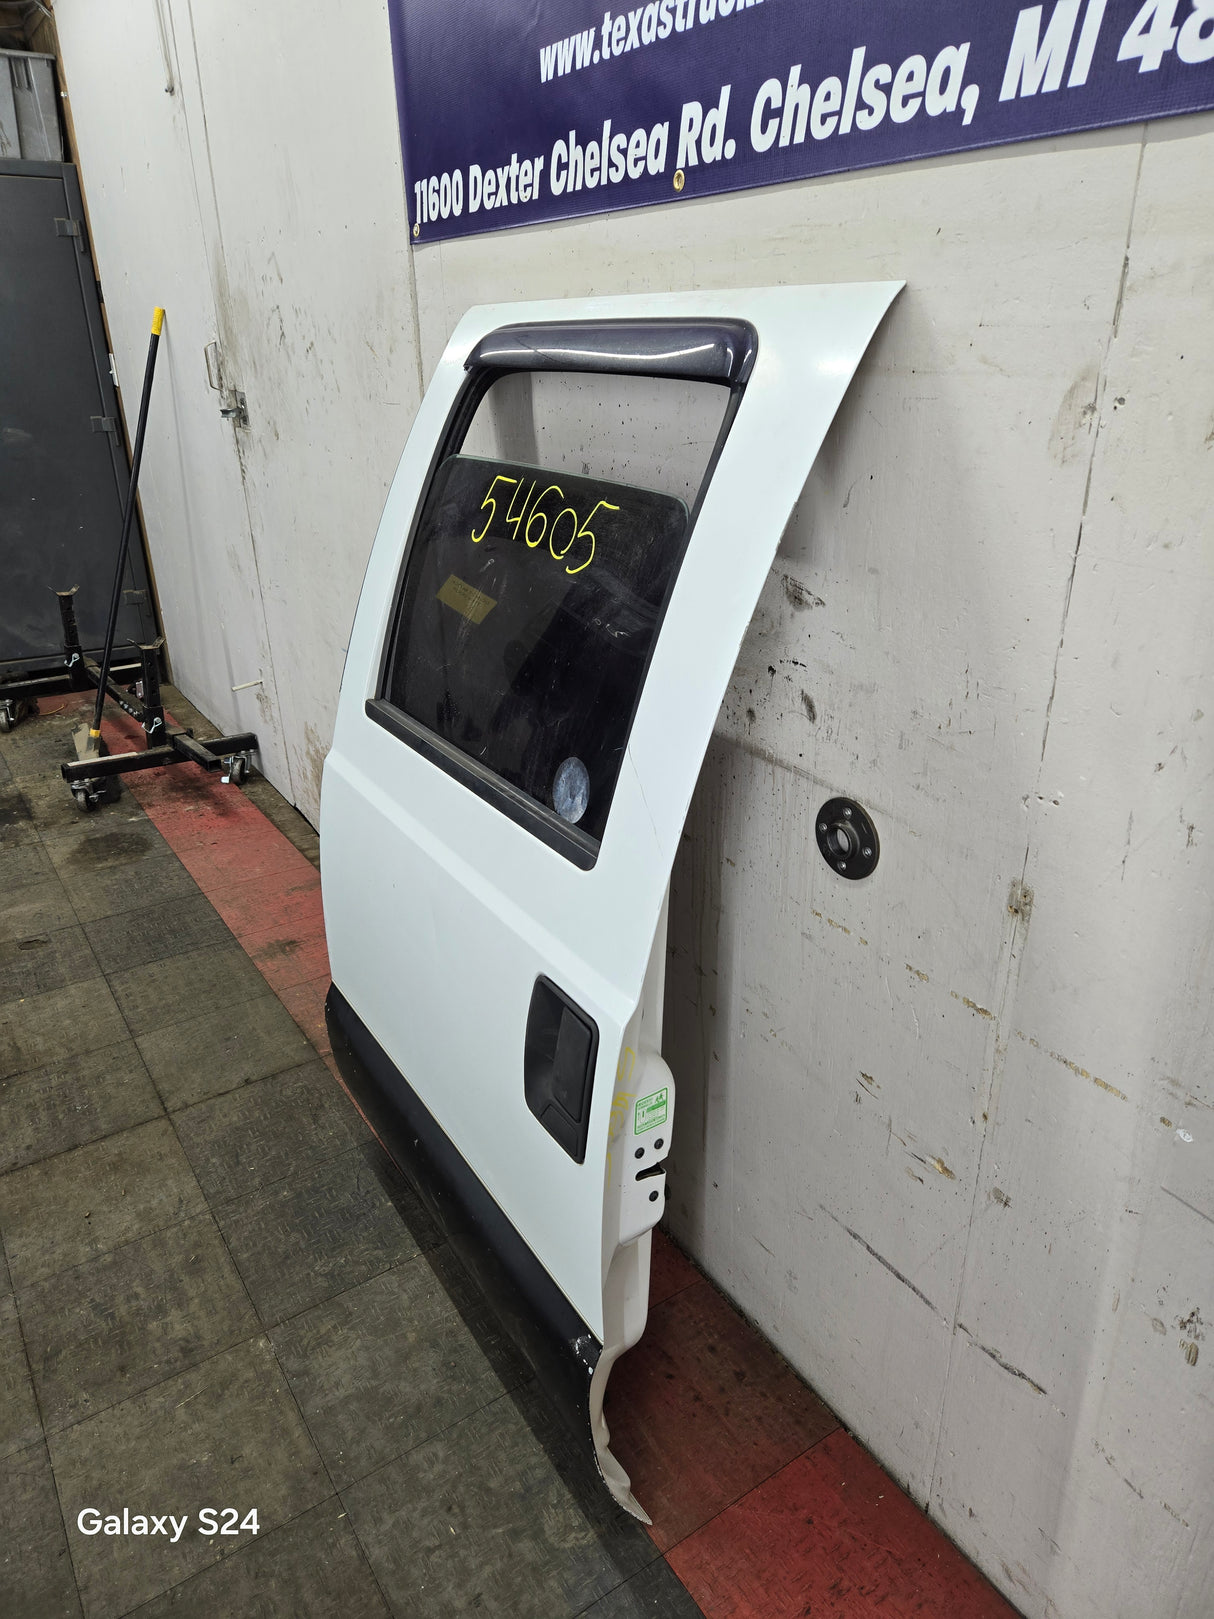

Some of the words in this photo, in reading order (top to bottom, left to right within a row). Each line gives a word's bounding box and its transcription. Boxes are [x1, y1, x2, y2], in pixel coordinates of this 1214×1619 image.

[414, 169, 463, 223] 11600
[469, 153, 544, 213] Dexter
[550, 119, 669, 196] Chelsea
[676, 84, 736, 168] Rd.
[750, 42, 979, 153] Chelsea,
[998, 0, 1108, 102] MI
[472, 475, 620, 574] 54605
